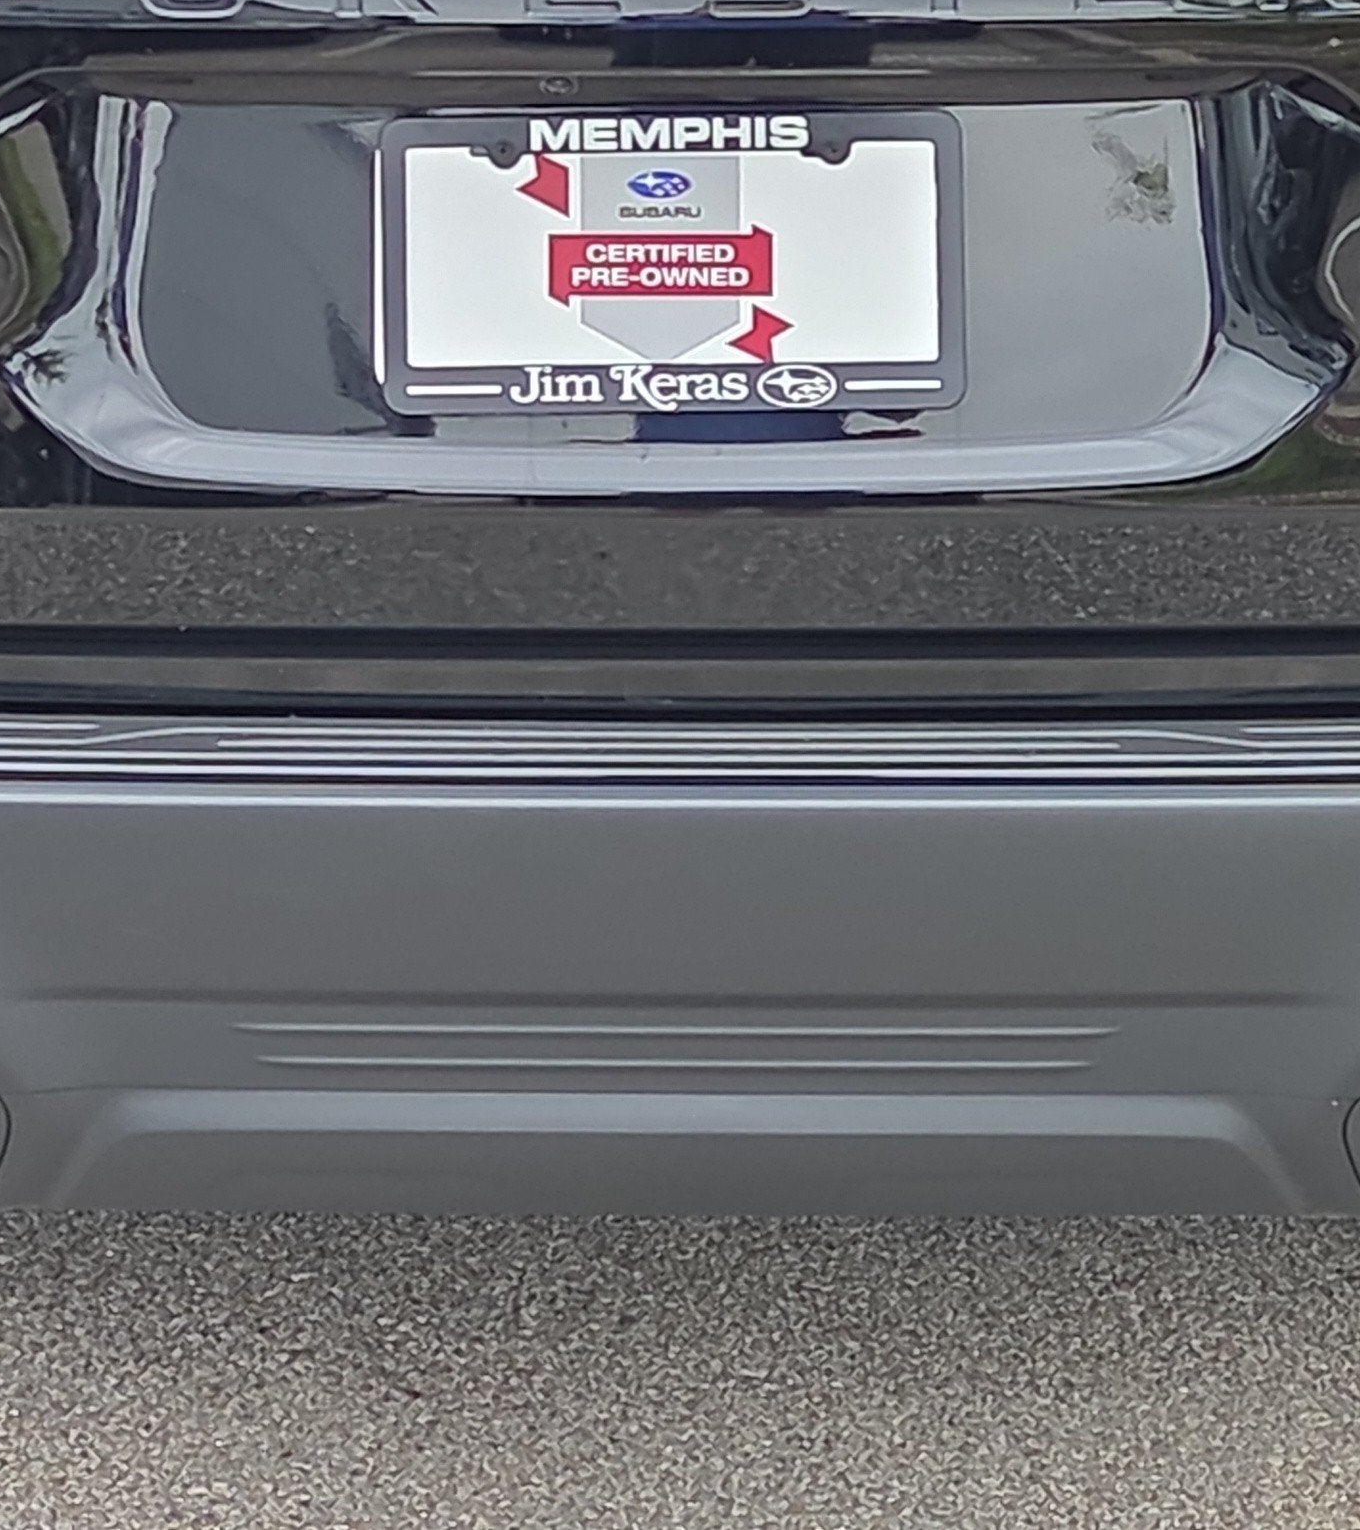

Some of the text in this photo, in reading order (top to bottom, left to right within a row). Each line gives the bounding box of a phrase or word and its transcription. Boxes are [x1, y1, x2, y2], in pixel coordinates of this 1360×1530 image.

[529, 115, 809, 152] MEMPHIS
[619, 206, 702, 218] SUBARU
[585, 243, 736, 263] CERTIFIED
[571, 266, 750, 287] PRE-OWNED
[509, 365, 750, 411] Jim Keras
